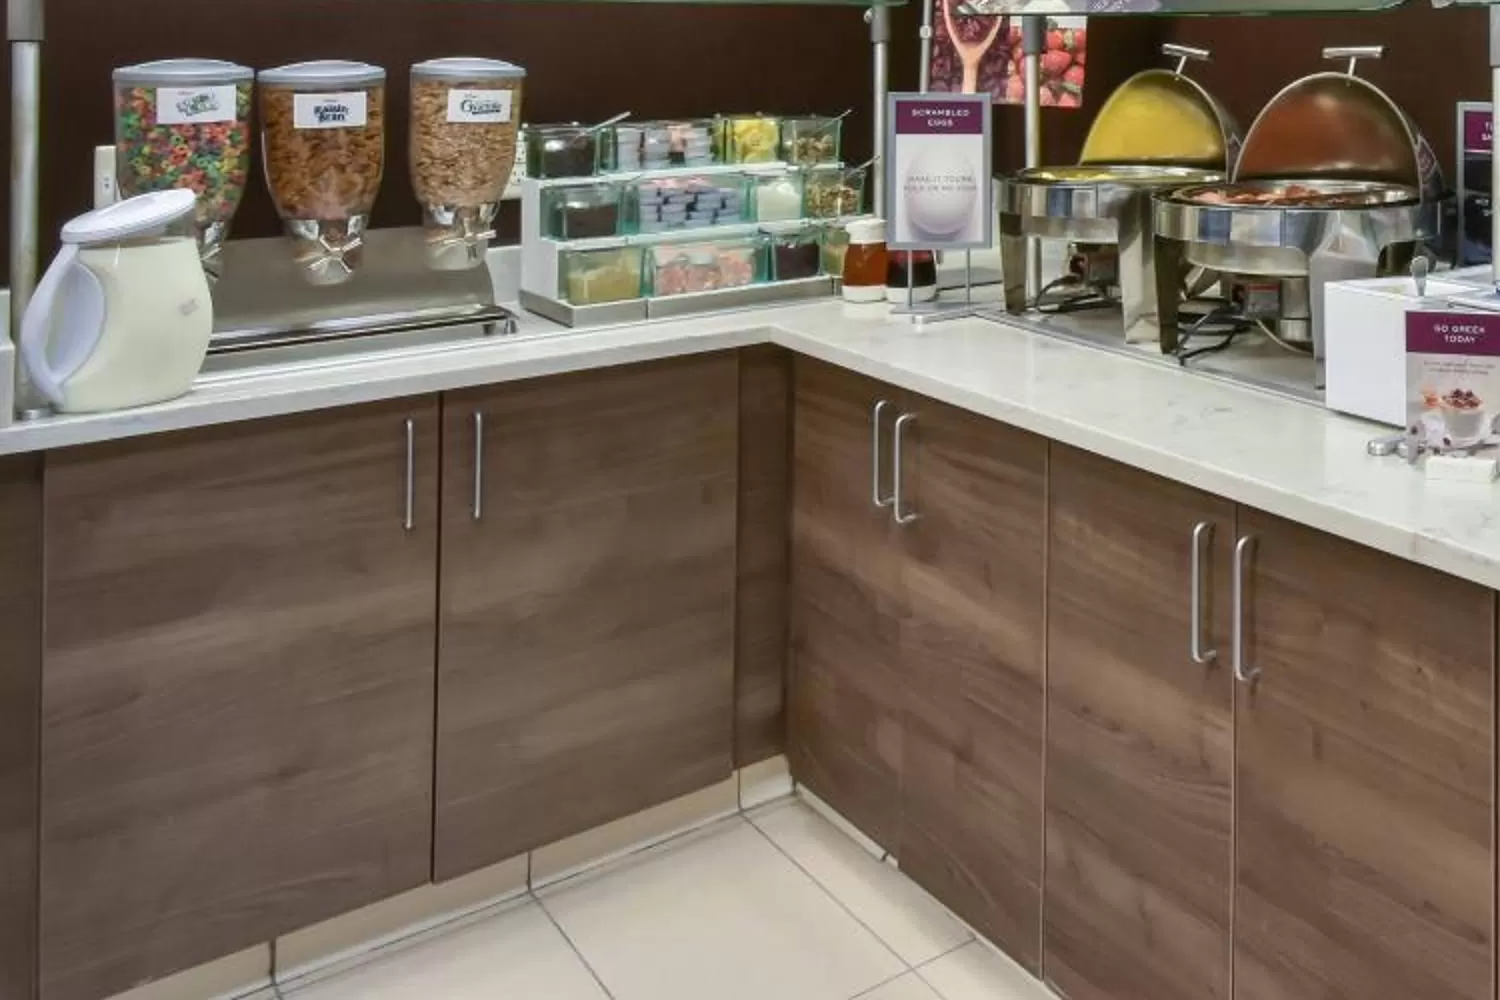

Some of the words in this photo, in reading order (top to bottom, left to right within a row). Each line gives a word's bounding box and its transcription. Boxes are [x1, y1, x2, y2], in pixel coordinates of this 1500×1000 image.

[911, 108, 970, 117] SCRAMBLED
[927, 118, 954, 127] EGGS
[1433, 324, 1449, 333] GO
[1451, 324, 1486, 334] GREEK
[1444, 334, 1476, 344] TODAY
